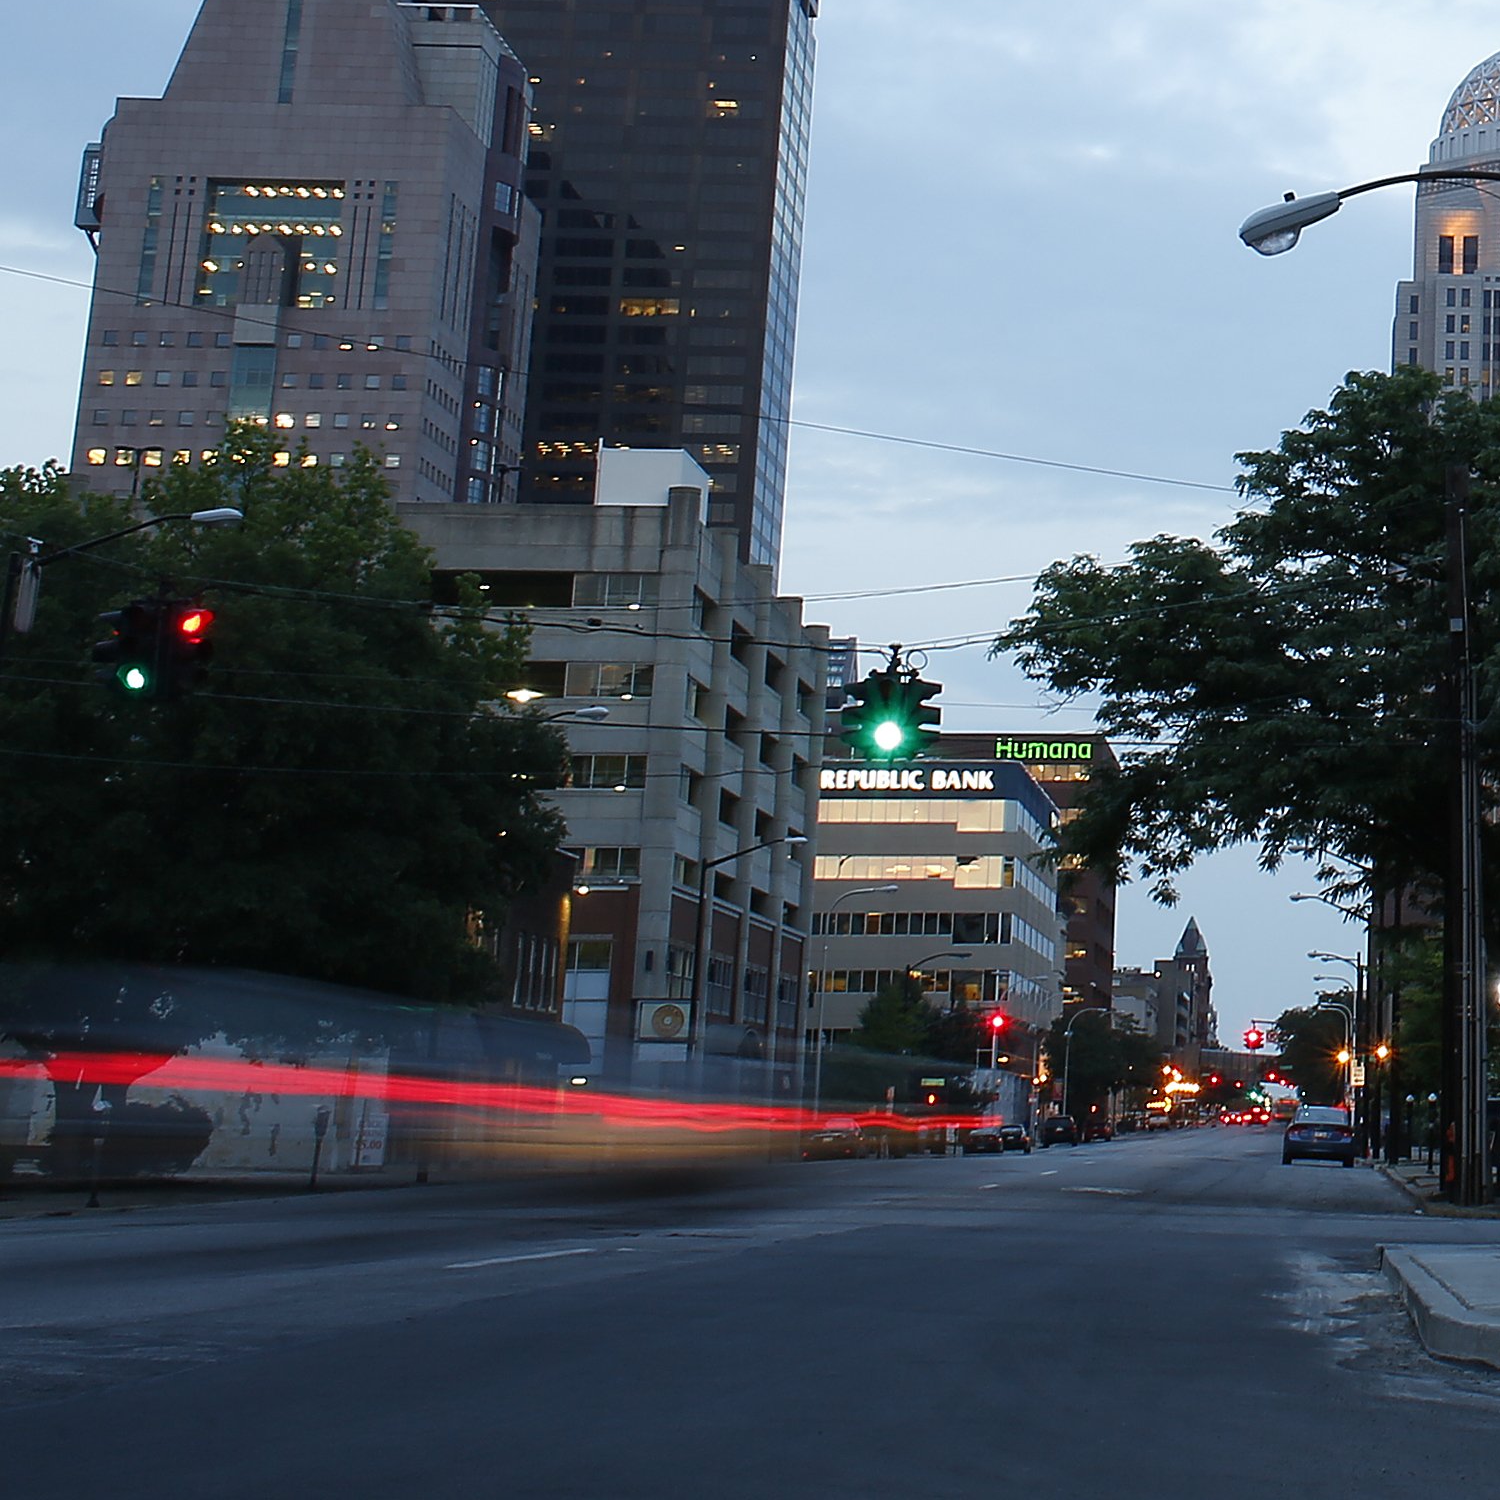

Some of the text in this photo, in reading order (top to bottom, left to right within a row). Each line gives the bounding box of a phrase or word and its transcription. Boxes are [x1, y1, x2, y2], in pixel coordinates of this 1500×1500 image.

[994, 737, 1093, 760] Humana
[819, 768, 995, 792] REPUBLIC BANK
